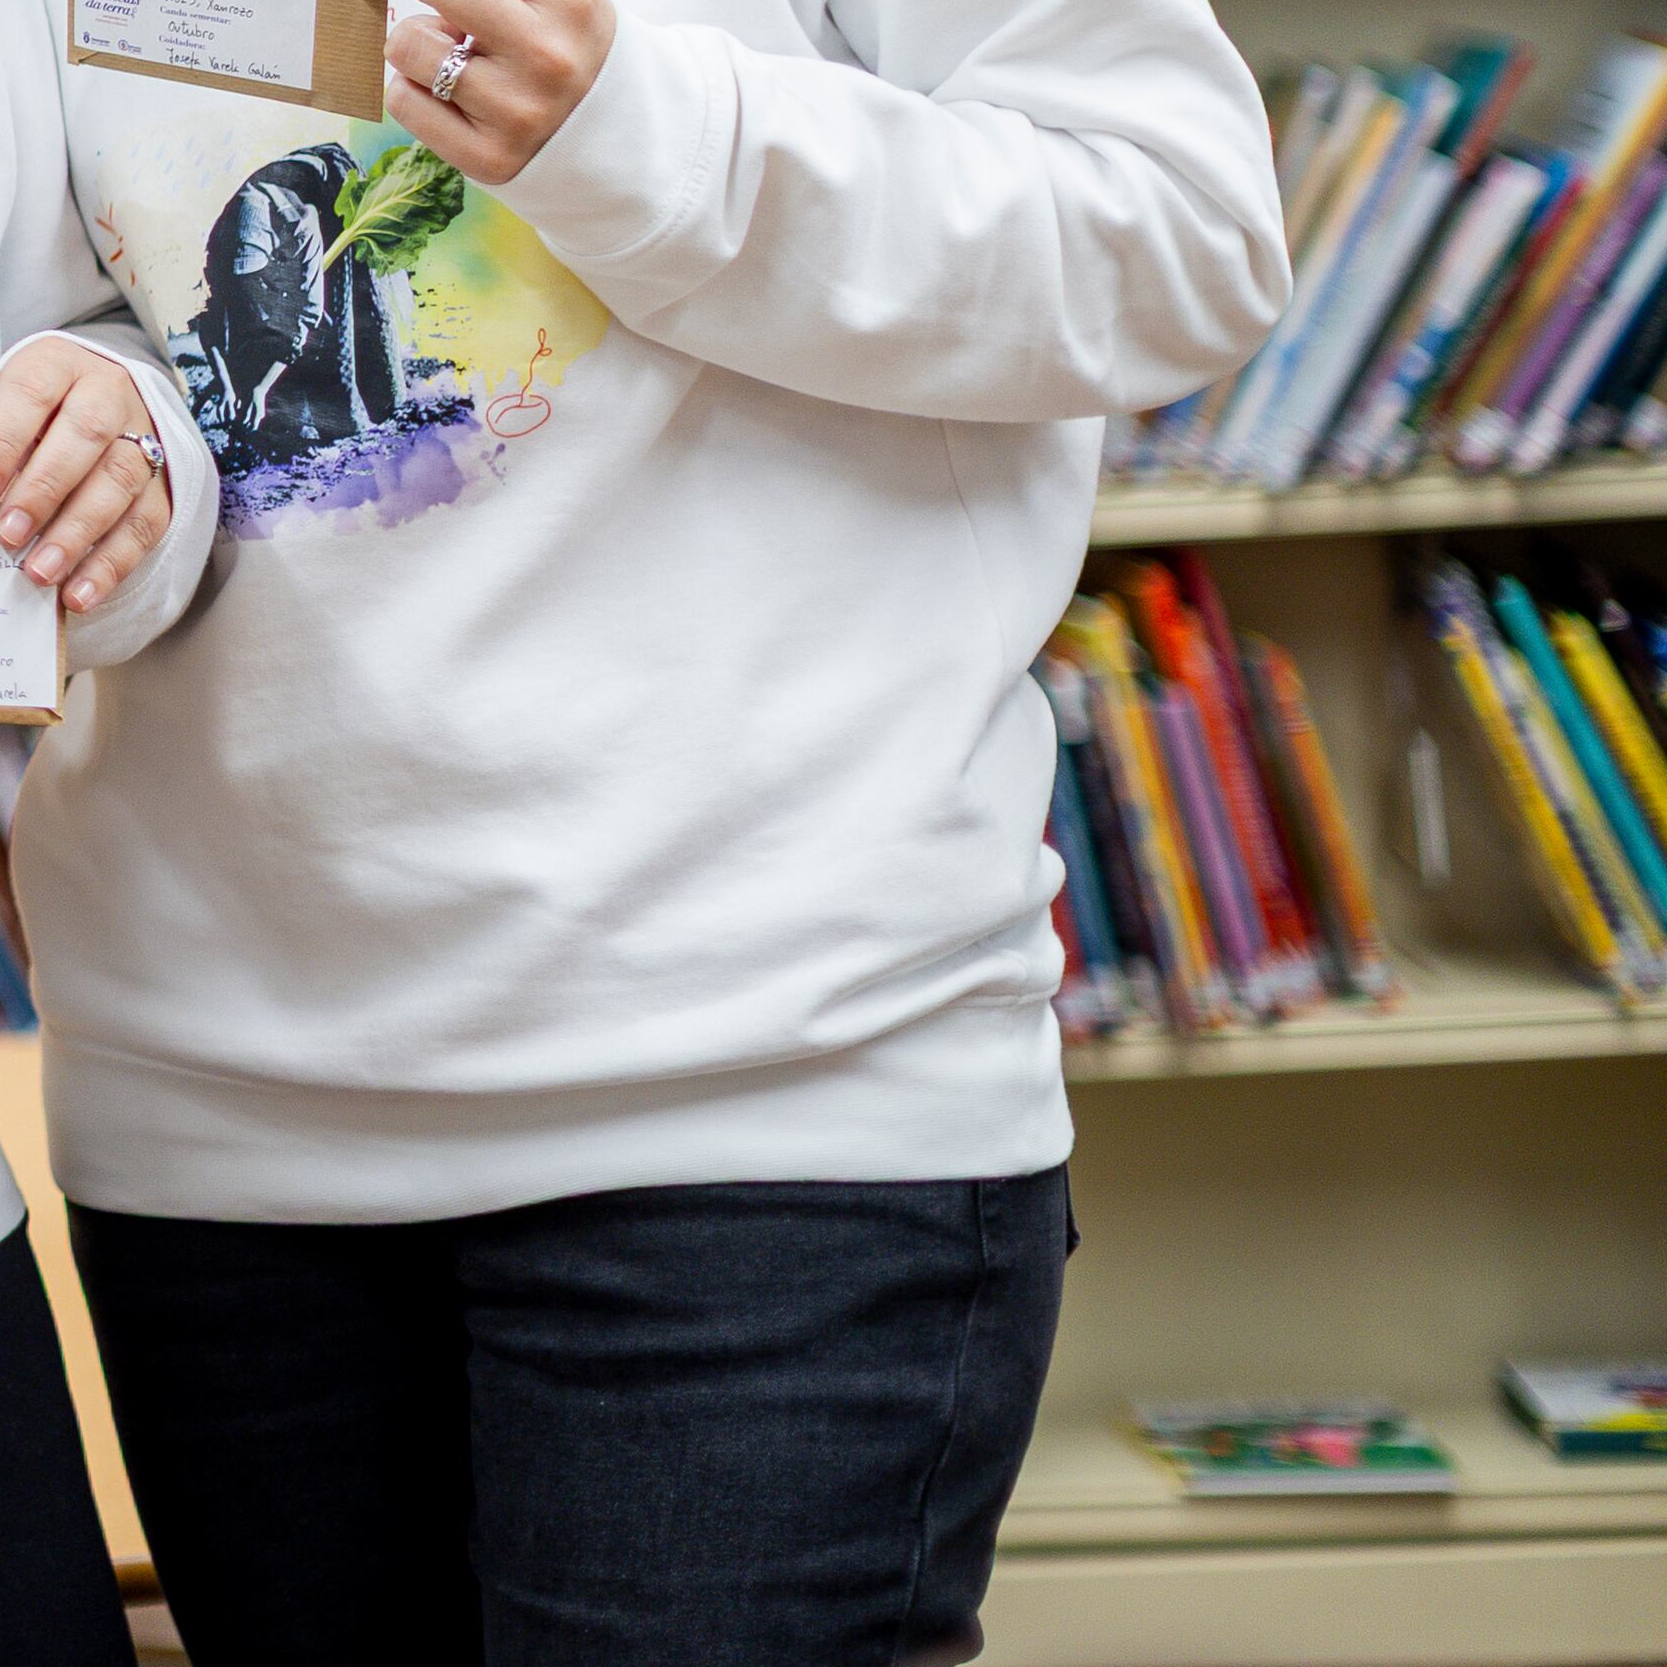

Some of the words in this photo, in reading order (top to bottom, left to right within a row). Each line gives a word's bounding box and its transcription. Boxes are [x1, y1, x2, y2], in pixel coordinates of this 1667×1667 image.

[102, 2, 131, 16] terra
[159, 5, 188, 17] Cando
[189, 13, 231, 25] sementar:
[158, 34, 206, 51] Coidadora:
[166, 47, 201, 71] Josefa
[208, 56, 240, 73] Varela
[247, 62, 281, 80] Galán
